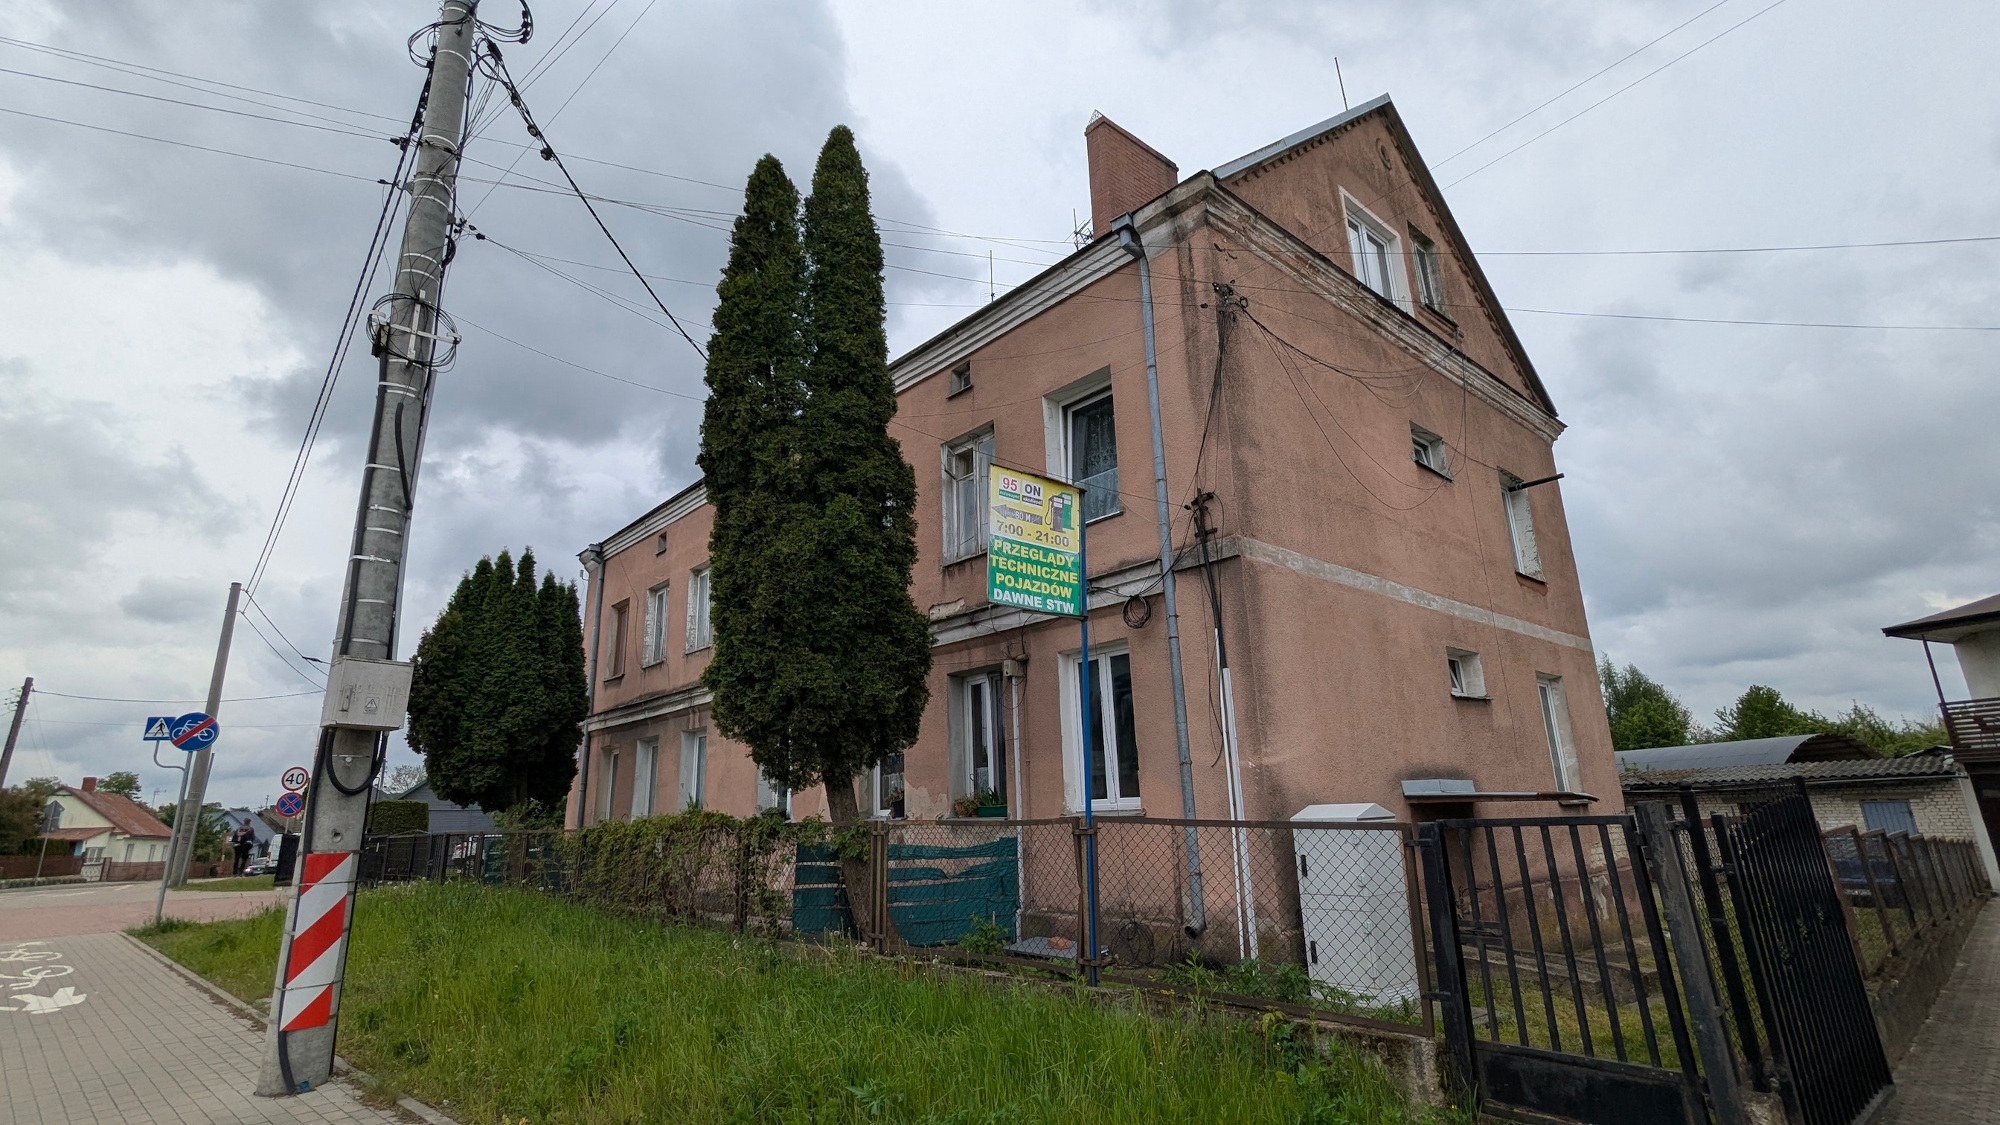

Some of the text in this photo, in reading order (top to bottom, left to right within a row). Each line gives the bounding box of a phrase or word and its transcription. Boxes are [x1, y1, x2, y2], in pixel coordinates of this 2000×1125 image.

[1003, 477, 1017, 491] 95
[1025, 484, 1041, 496] ON
[1015, 511, 1024, 520] 80
[997, 520, 1023, 536] 7:00
[1036, 530, 1069, 547] 21:00
[994, 539, 1074, 568] PRZEGLĄDY
[990, 555, 1078, 584] TECHNICZNE
[996, 572, 1072, 598] POJAZDÓW
[993, 588, 1074, 614] DAWNE STW
[285, 773, 305, 784] 40
